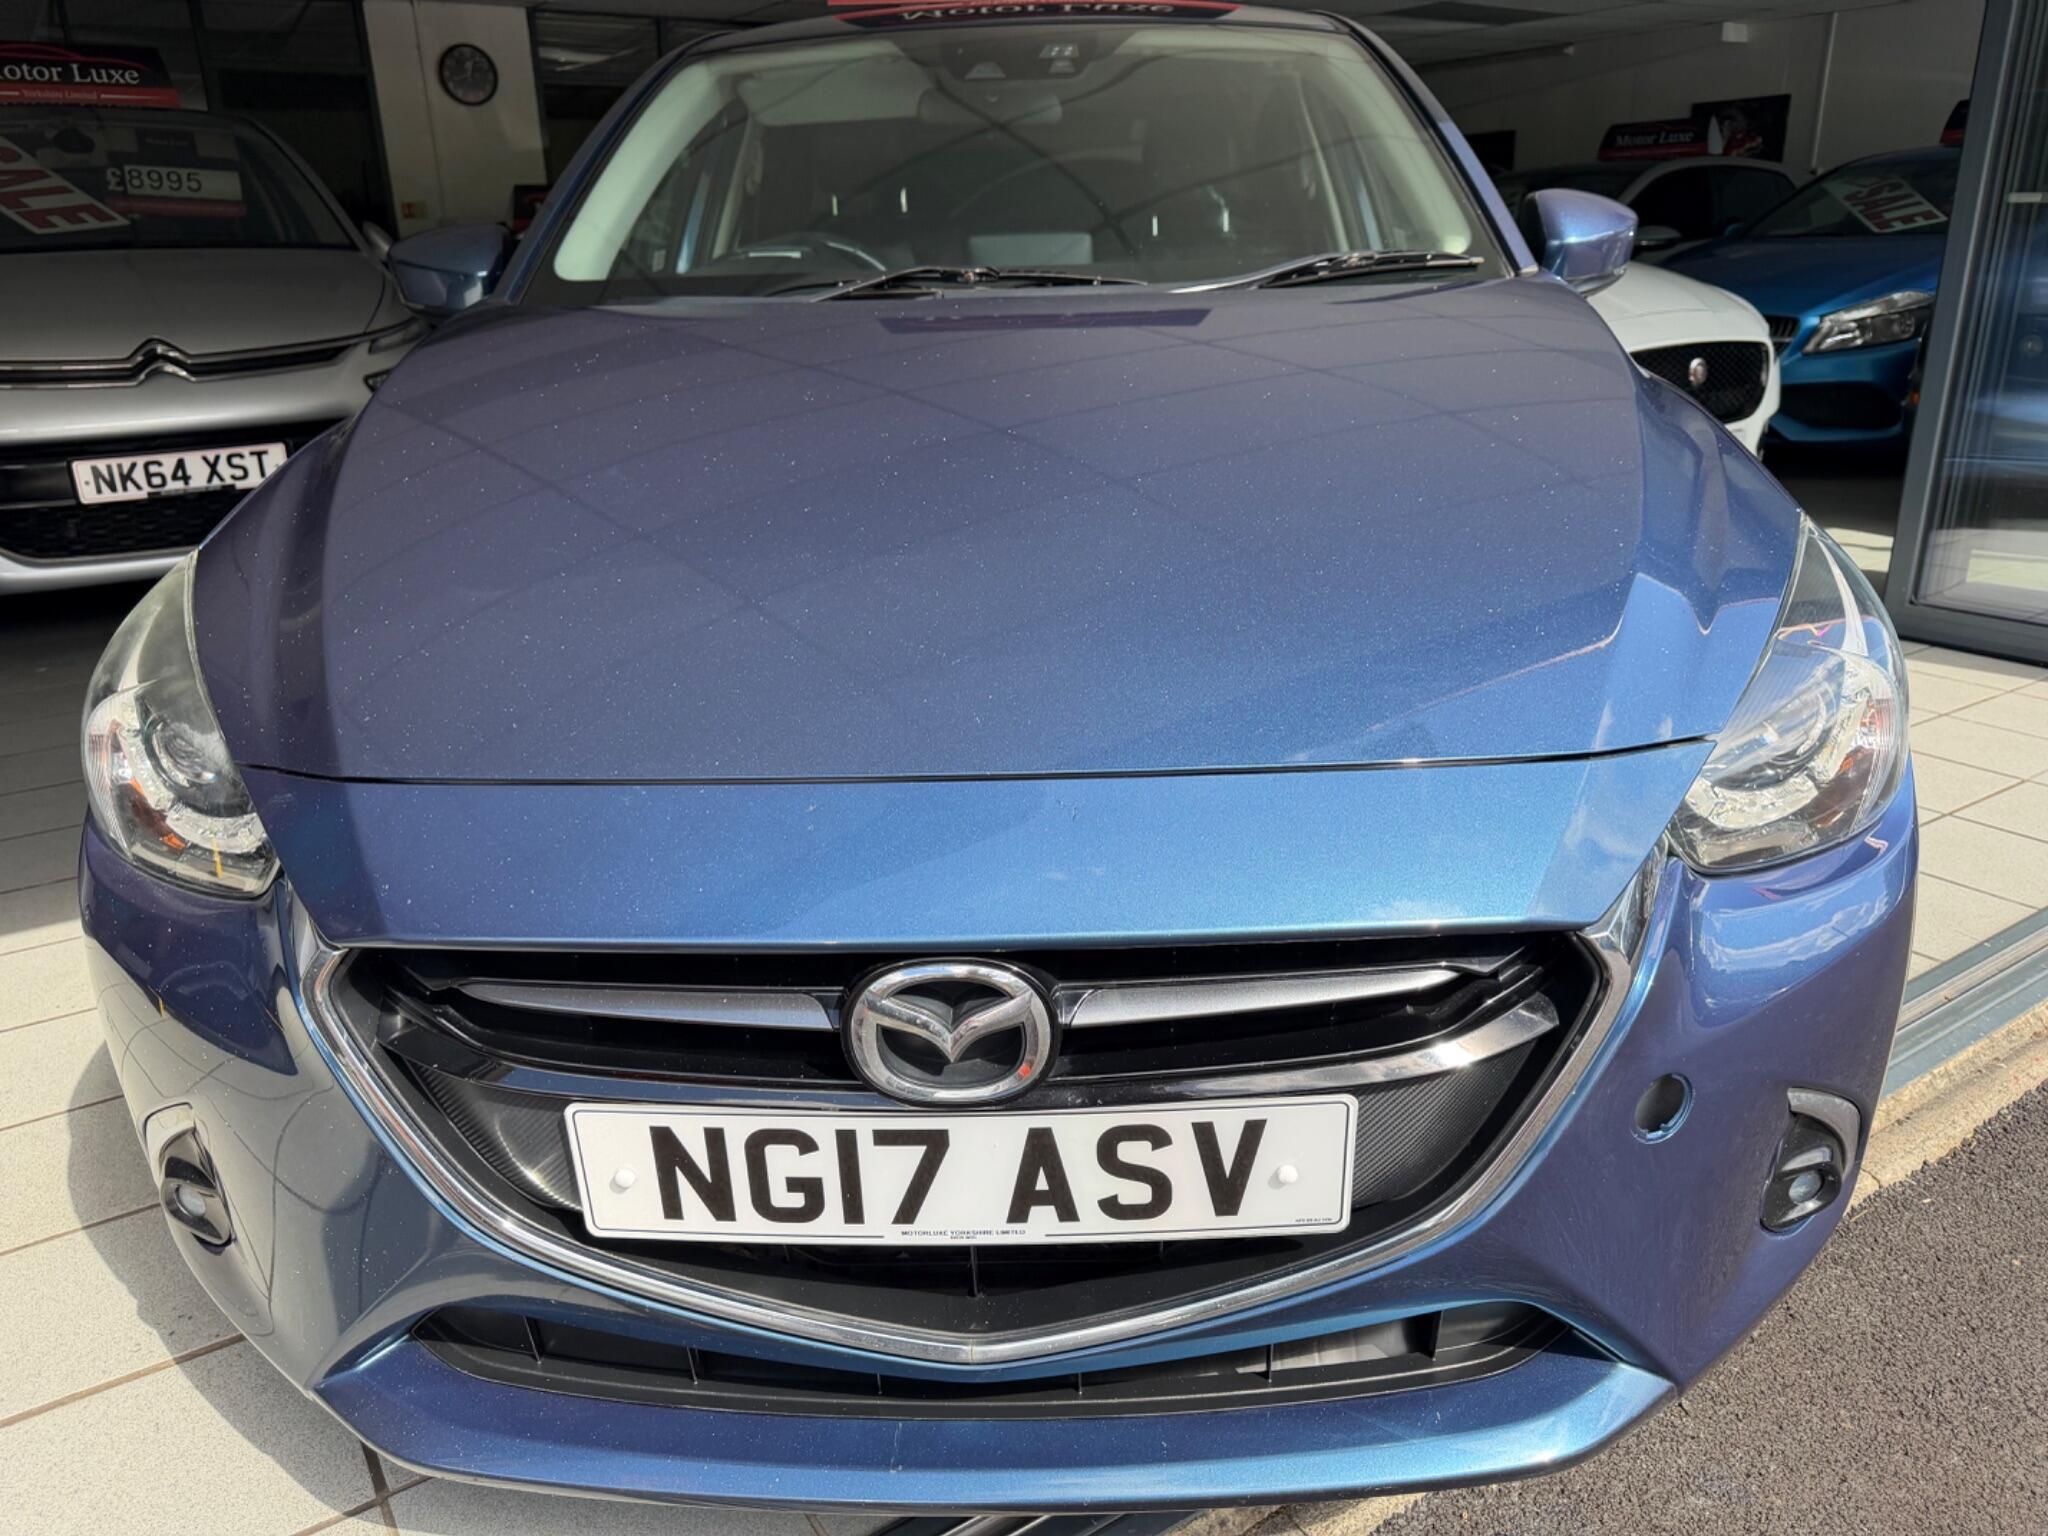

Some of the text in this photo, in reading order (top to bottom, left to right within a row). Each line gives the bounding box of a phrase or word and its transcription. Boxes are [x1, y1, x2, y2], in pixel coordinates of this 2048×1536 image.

[0, 63, 140, 84] otor Luxe
[106, 167, 203, 193] £8995
[1844, 181, 1939, 230] SALE
[90, 449, 269, 495] NK64 XST
[649, 1119, 1268, 1225] NG17 ASV
